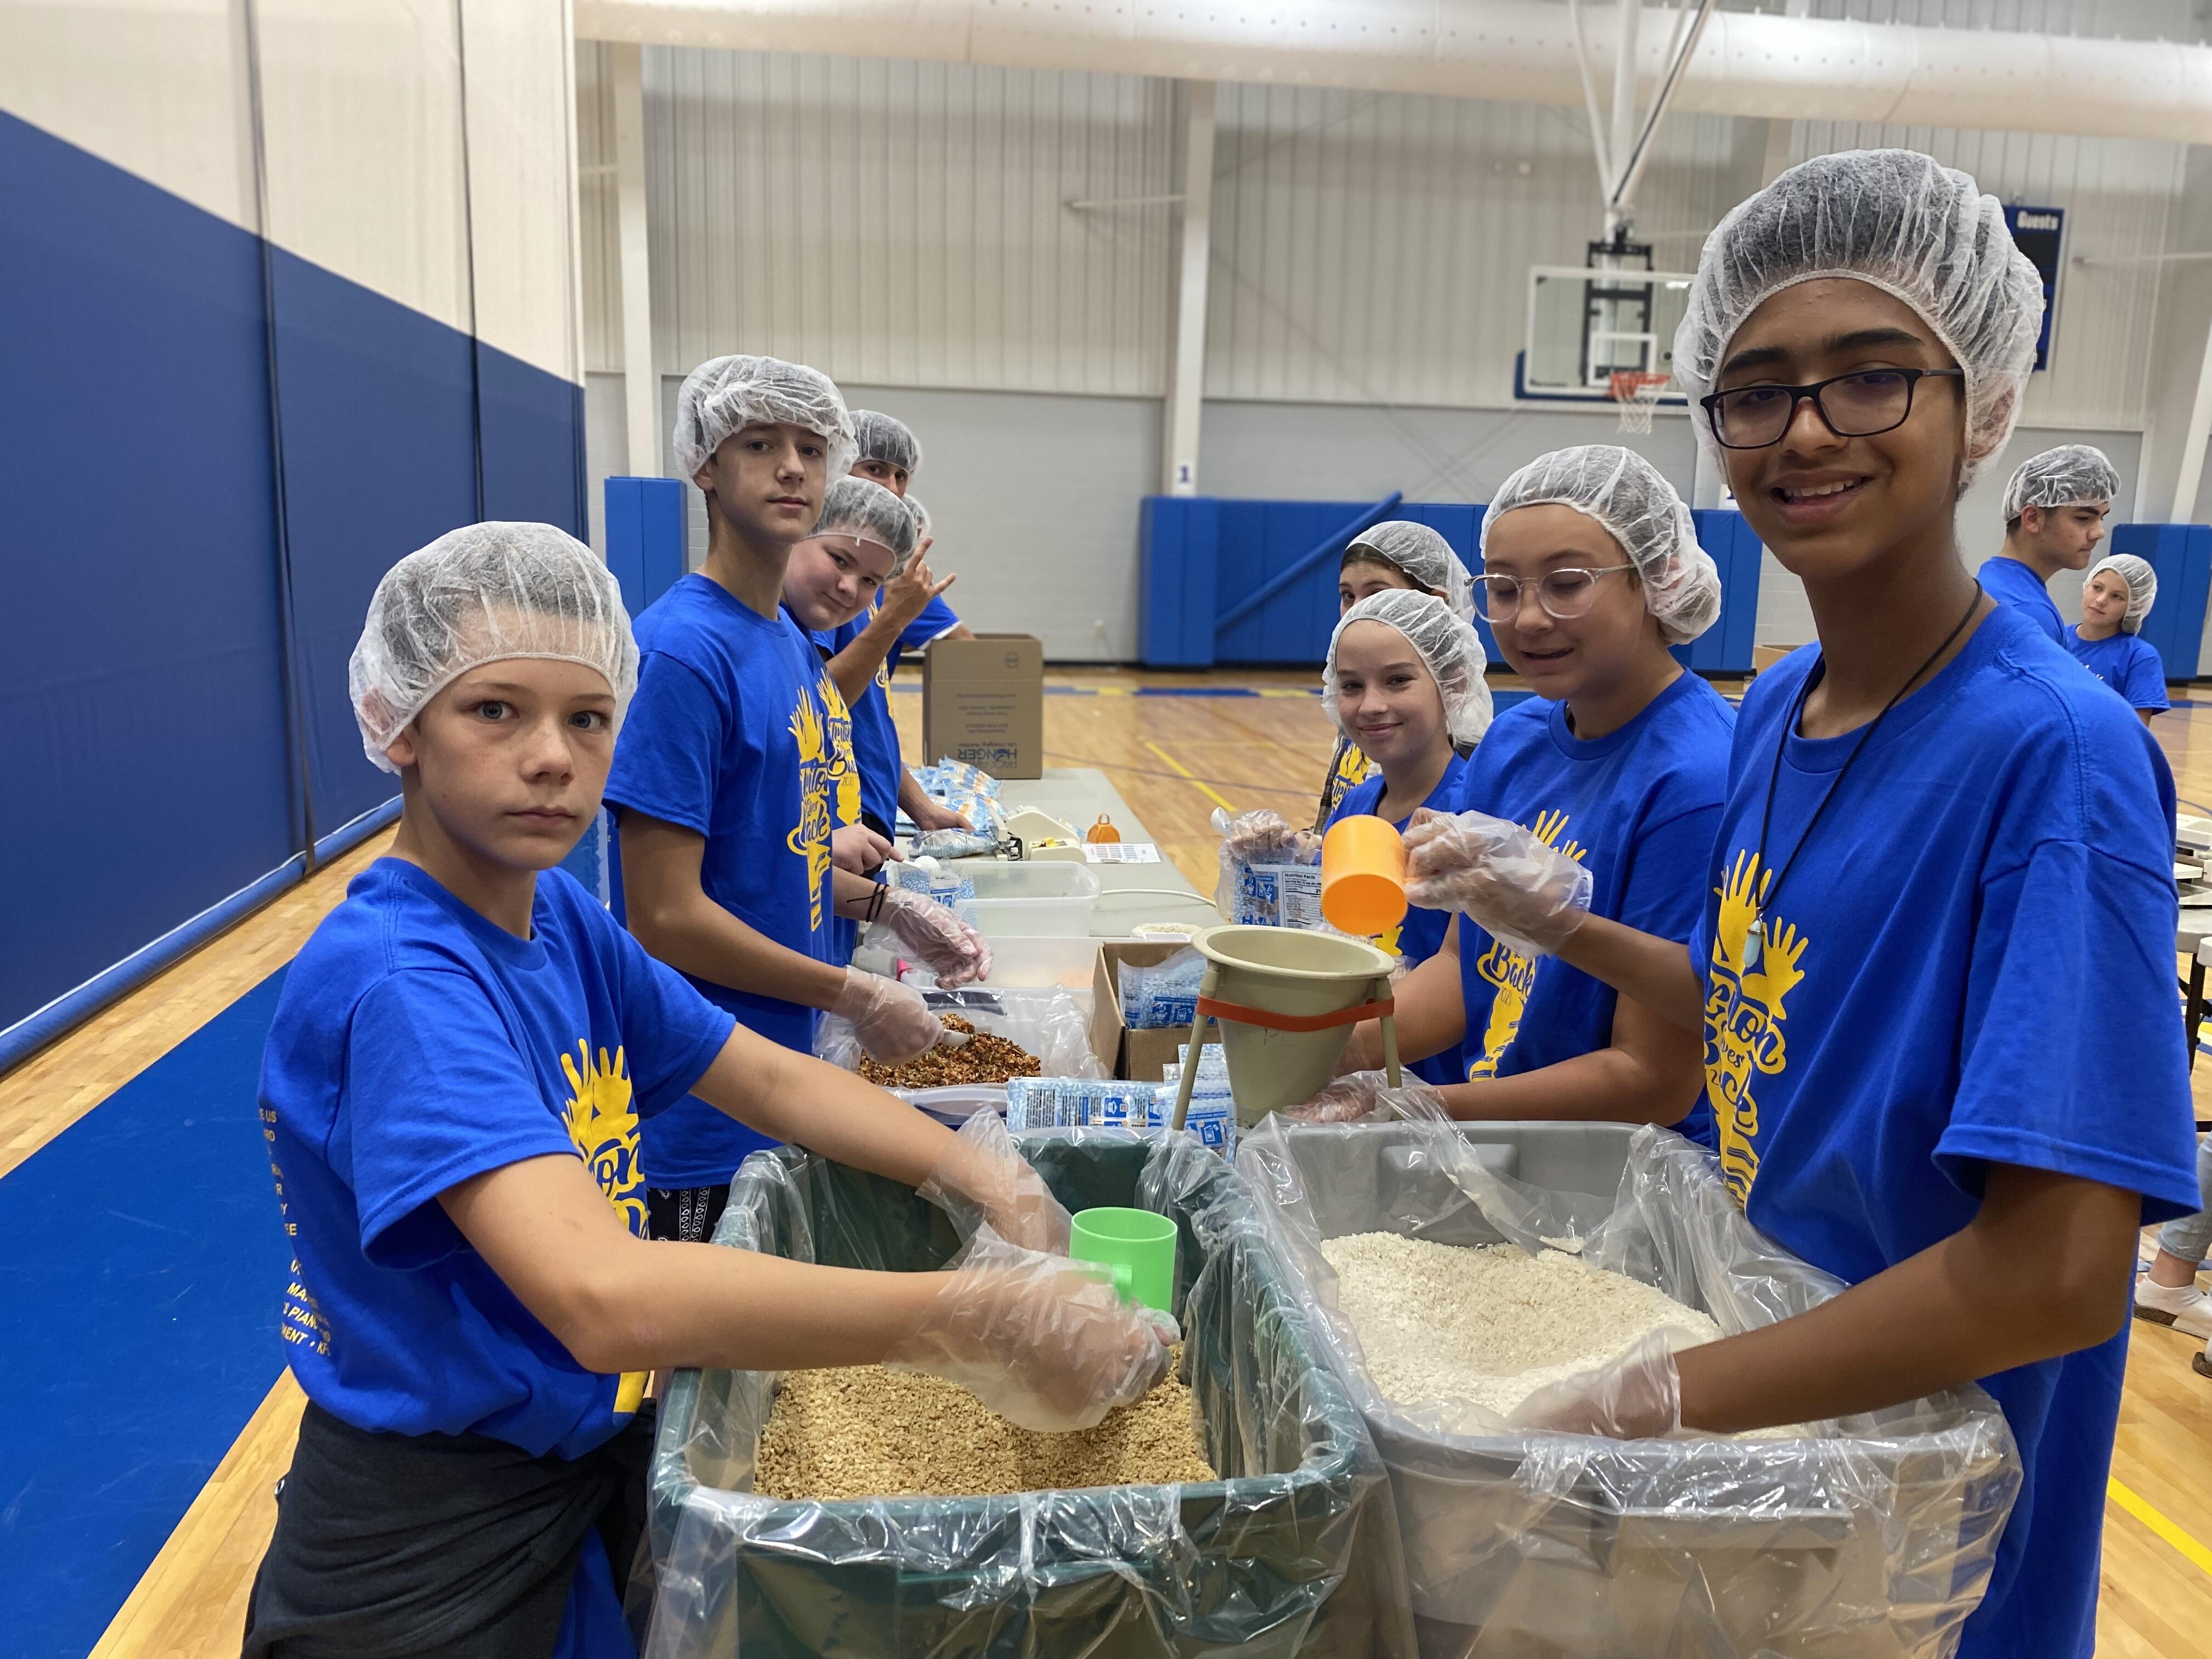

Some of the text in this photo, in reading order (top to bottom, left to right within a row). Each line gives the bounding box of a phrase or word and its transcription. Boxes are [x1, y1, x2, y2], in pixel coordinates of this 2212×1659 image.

[2017, 211, 2059, 230] Guests
[1179, 465, 1190, 482] 1
[992, 760, 1017, 769] PACK
